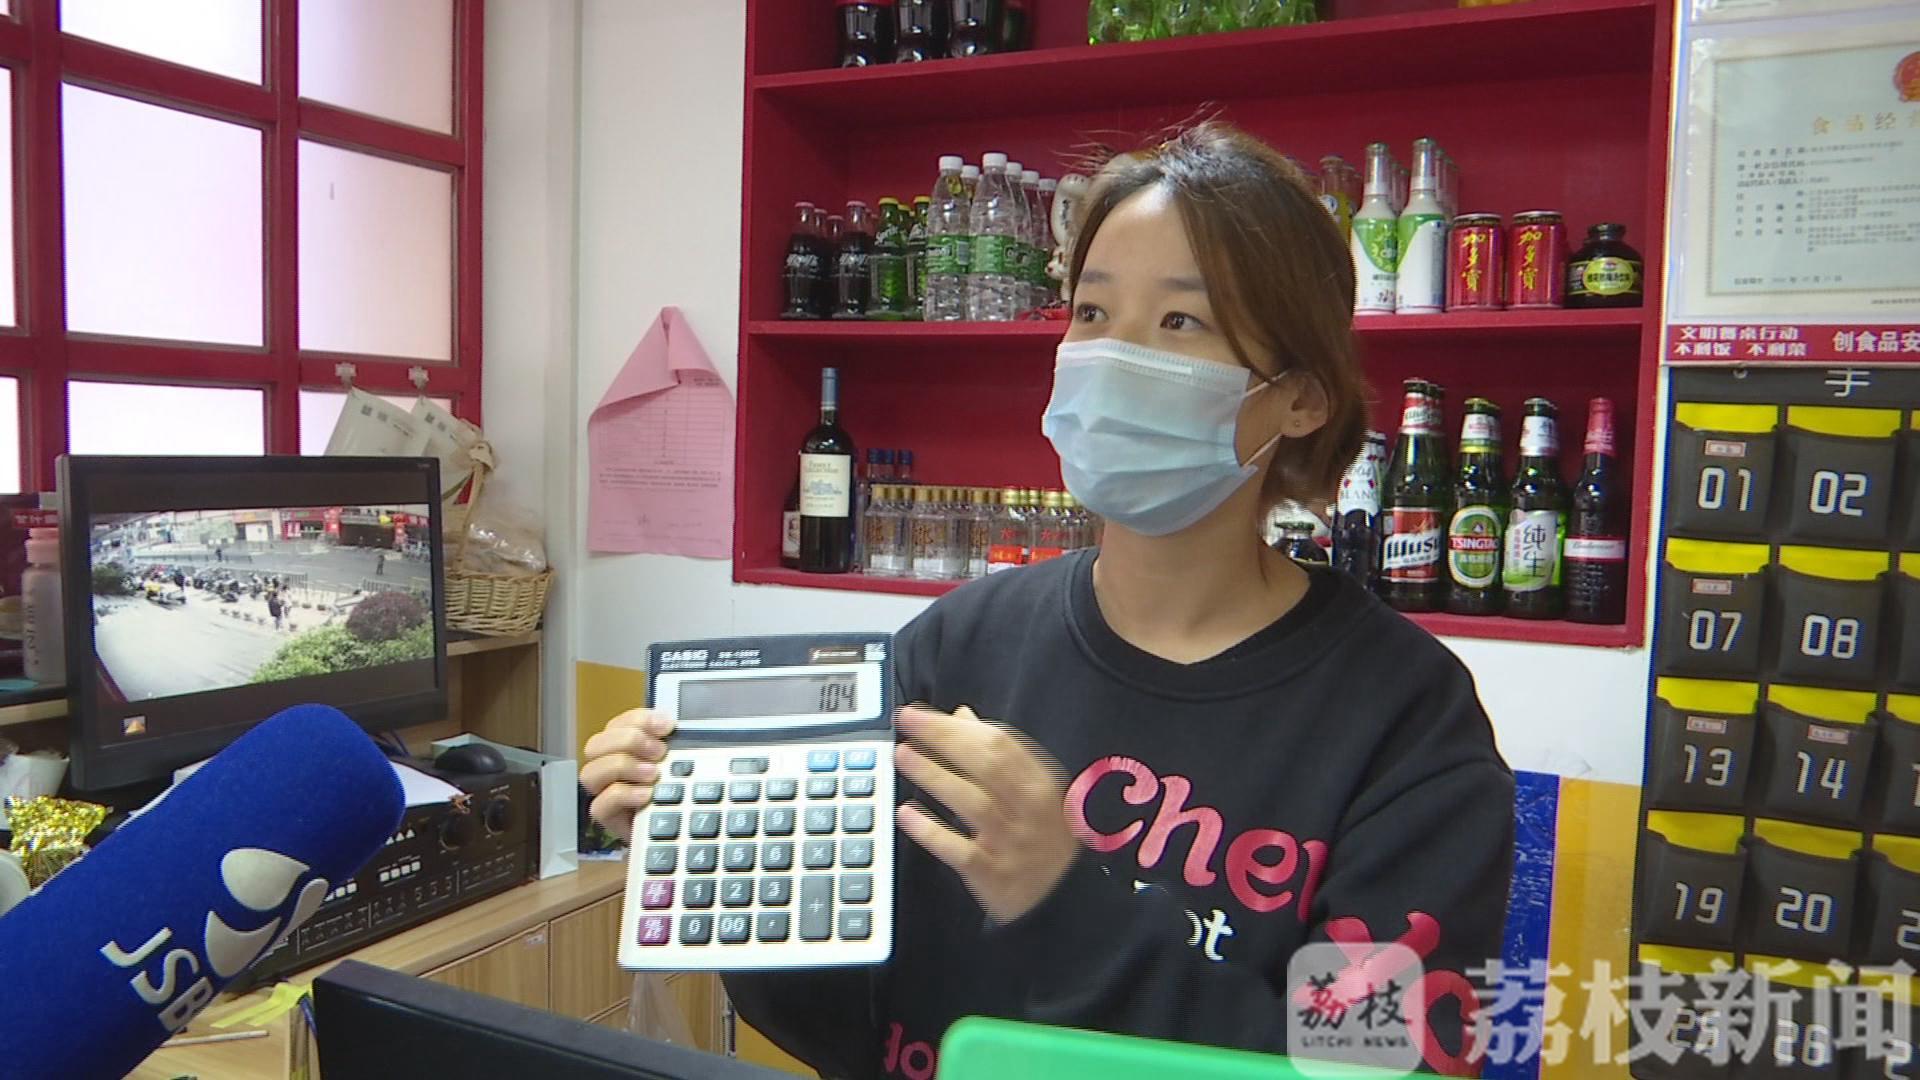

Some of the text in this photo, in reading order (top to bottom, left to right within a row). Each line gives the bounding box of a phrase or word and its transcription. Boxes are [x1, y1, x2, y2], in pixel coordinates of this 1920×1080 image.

[1698, 467, 1752, 511] 01
[1809, 470, 1868, 516] 02
[1523, 524, 1546, 577] 纯生
[1689, 609, 1742, 651] 07
[1800, 614, 1859, 659] 08
[660, 649, 709, 662] CASIO
[819, 683, 857, 713] 104
[1684, 744, 1732, 786] 13
[1796, 750, 1846, 799] 14
[693, 849, 706, 863] 4
[732, 847, 745, 862] 5
[693, 881, 780, 899] 1 2 3
[1674, 881, 1724, 925] 19
[1775, 886, 1833, 933] 20
[688, 917, 745, 934] 0 00
[1670, 1007, 1720, 1055] 25
[1773, 1018, 1831, 1067] 26
